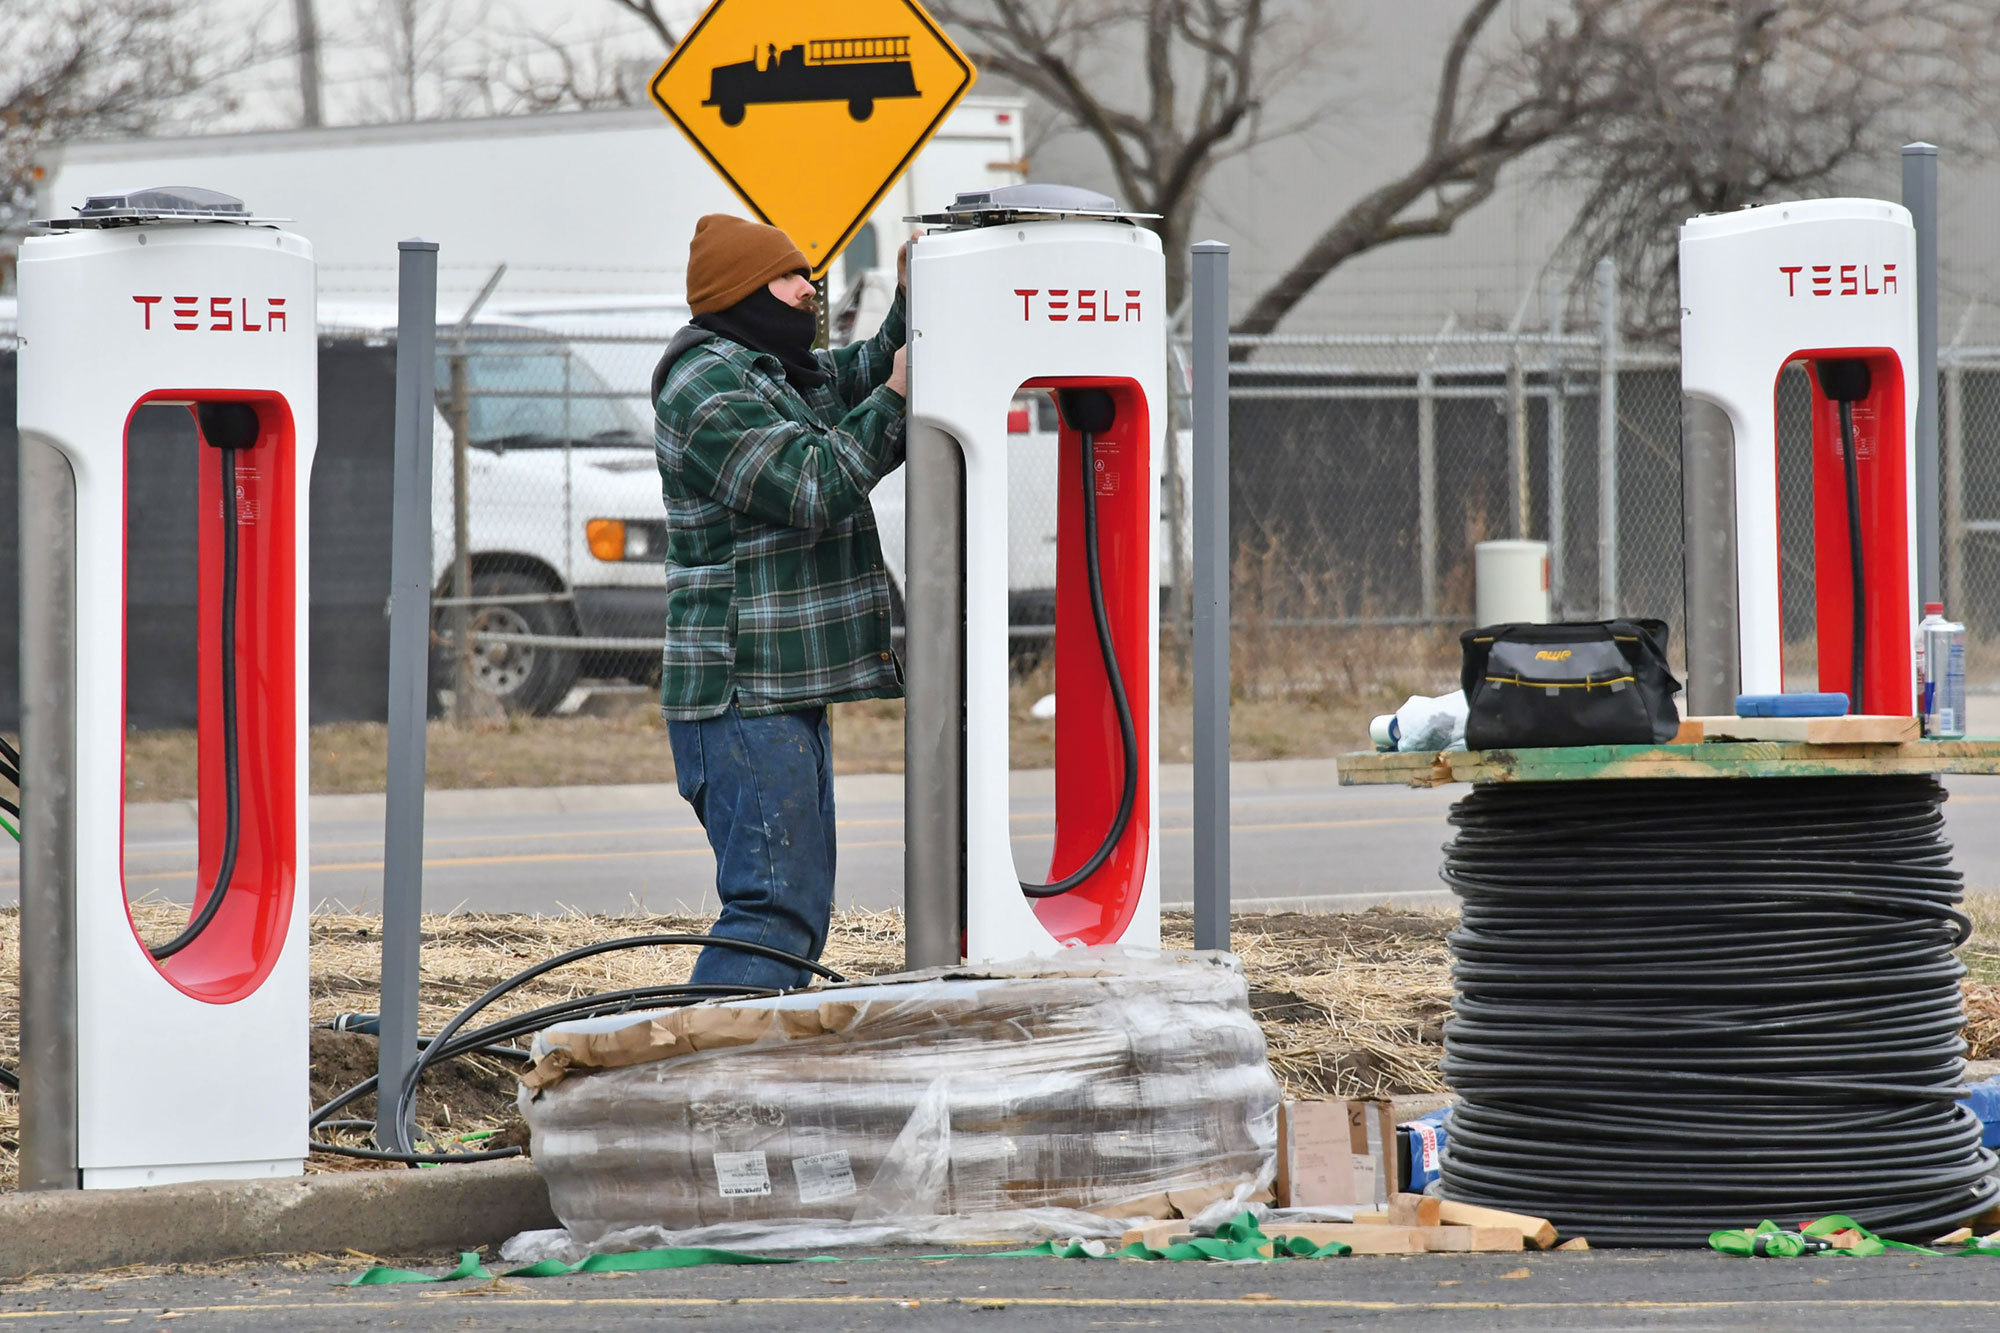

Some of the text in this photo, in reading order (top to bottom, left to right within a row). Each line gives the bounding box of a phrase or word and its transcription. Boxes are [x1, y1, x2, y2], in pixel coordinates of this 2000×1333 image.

[1780, 263, 1897, 296] TESLA
[132, 296, 287, 332] TESLA
[1014, 289, 1141, 322] TESLA
